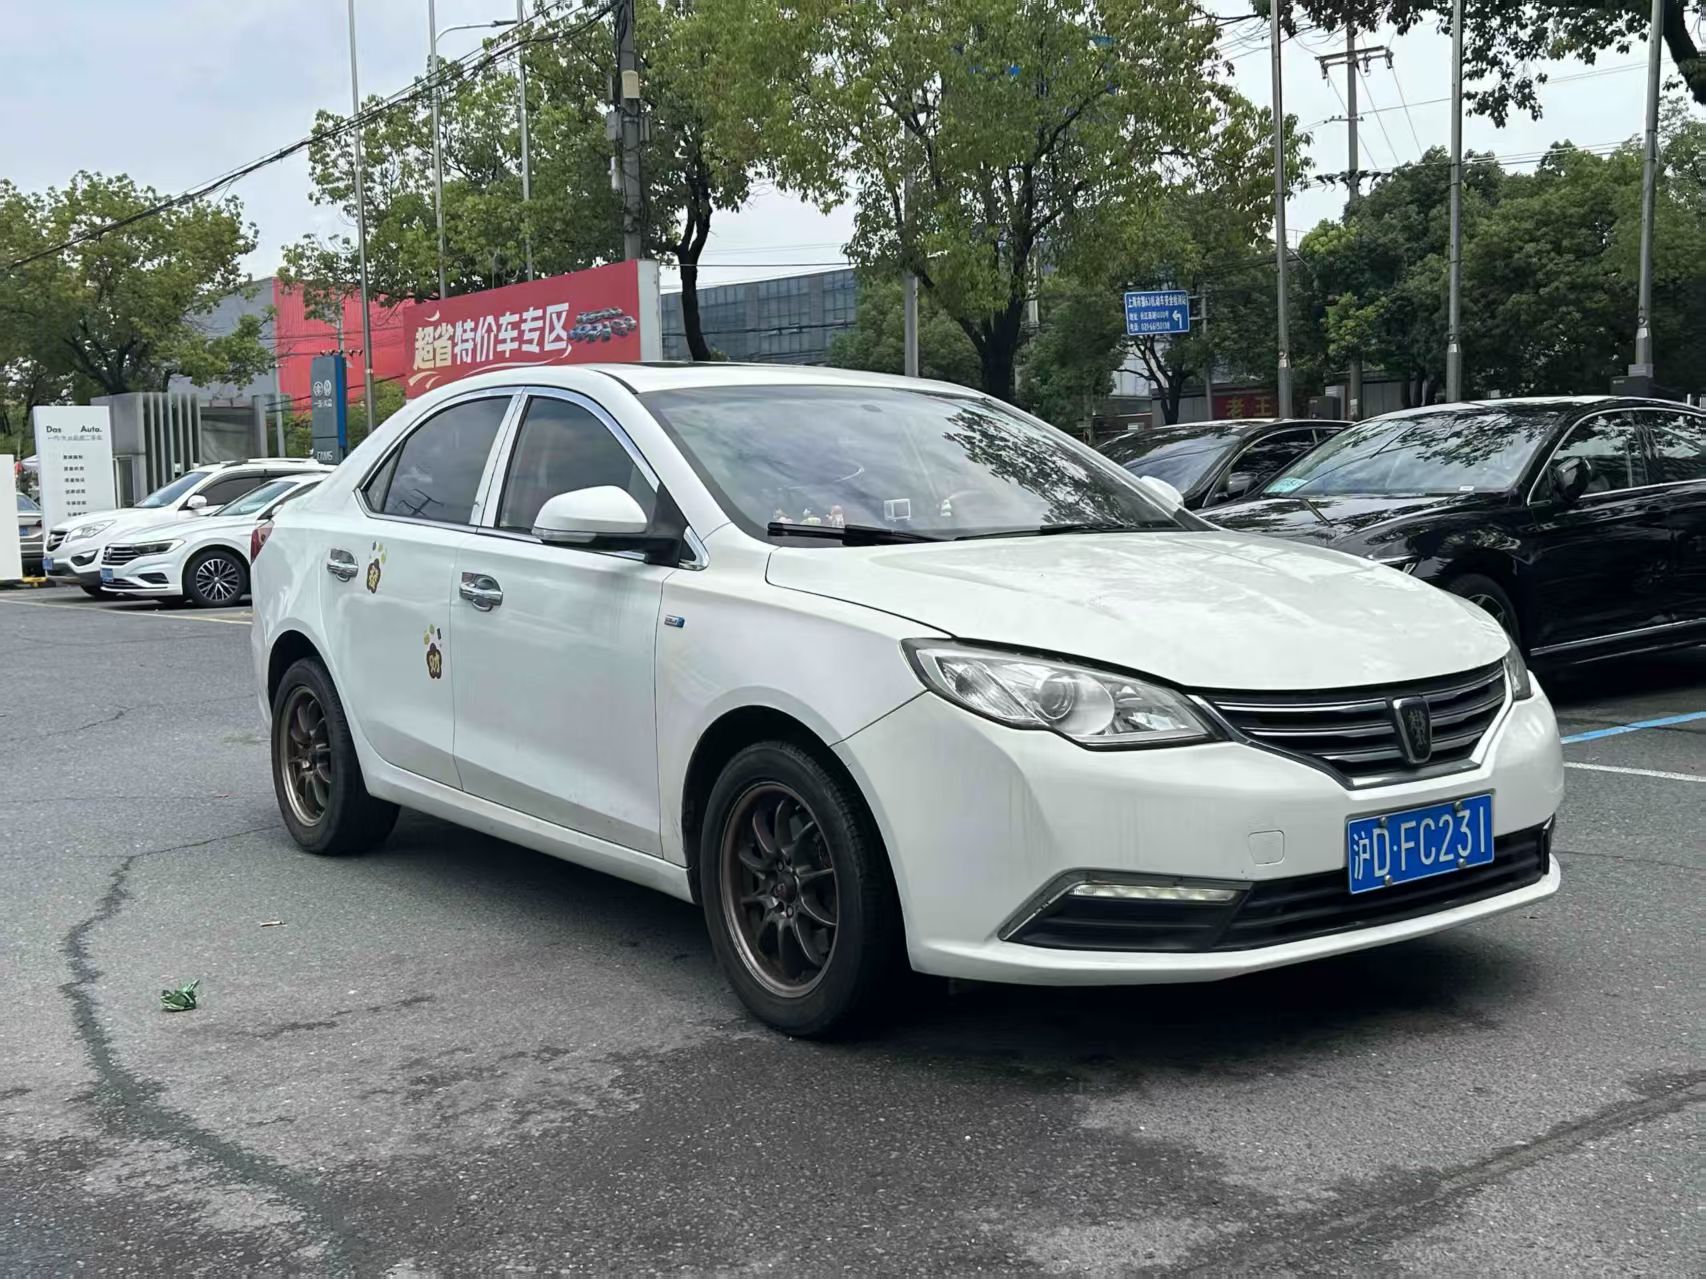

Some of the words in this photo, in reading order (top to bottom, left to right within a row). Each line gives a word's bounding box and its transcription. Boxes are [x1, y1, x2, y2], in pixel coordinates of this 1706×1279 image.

[413, 303, 569, 371] 超省特价车专区
[46, 425, 62, 433] Das
[80, 424, 103, 433] Auto.
